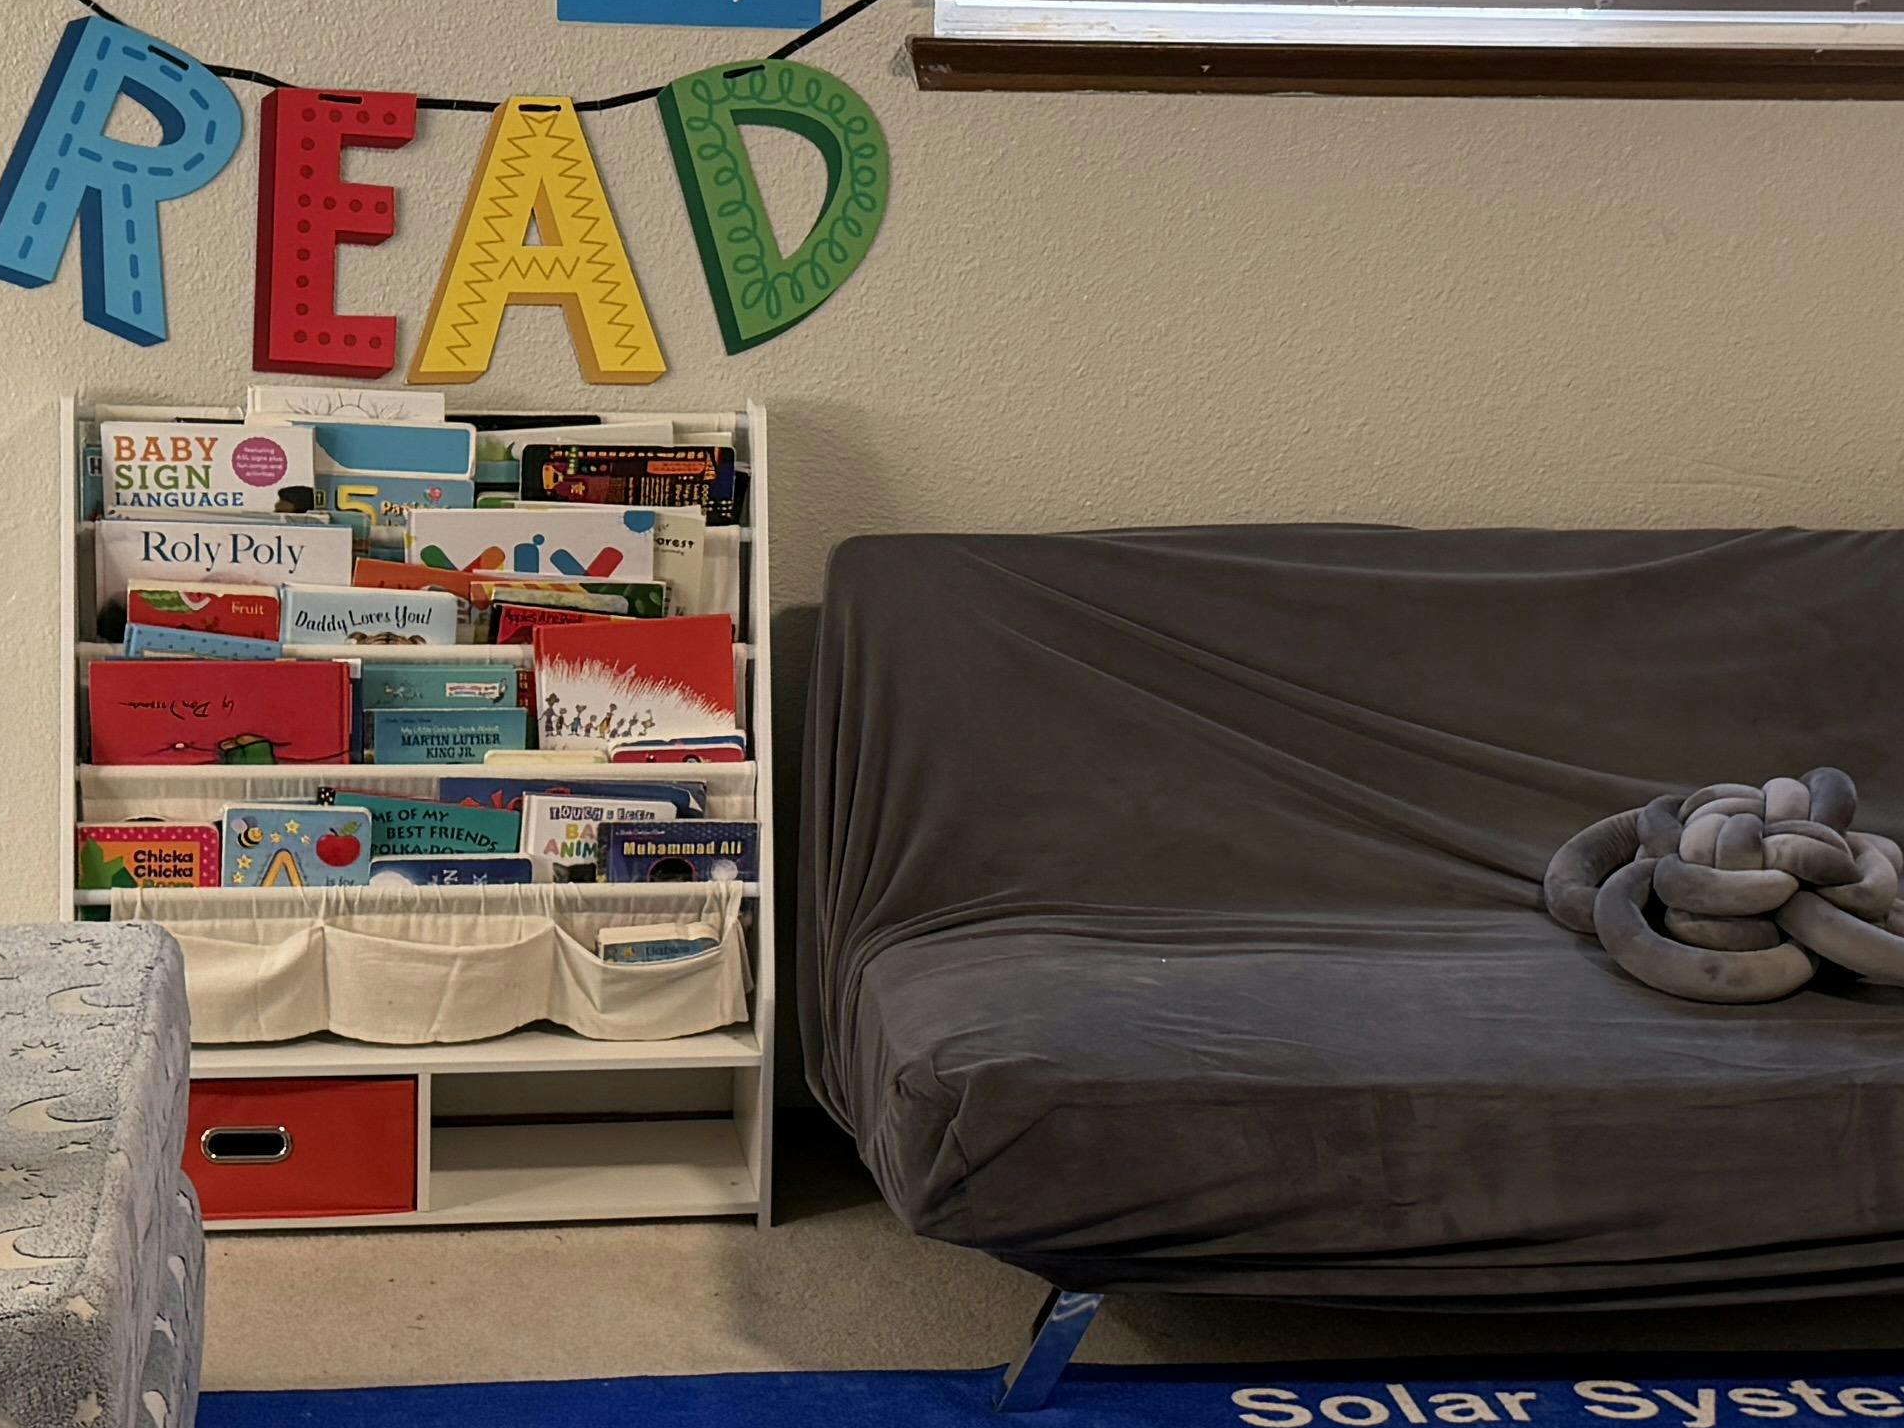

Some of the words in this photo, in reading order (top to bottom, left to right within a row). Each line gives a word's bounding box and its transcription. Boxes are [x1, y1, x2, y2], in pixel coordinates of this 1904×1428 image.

[113, 435, 219, 463] BABY
[114, 464, 212, 490] SIGN
[114, 491, 245, 508] LANGUAGE
[336, 484, 380, 526] 5
[653, 537, 696, 549] orest
[141, 530, 223, 572] Roly
[229, 533, 305, 574] Poly
[231, 600, 265, 616] Fruit
[295, 609, 348, 634] Daddy
[351, 609, 392, 627] Loves
[393, 605, 434, 628] You!
[181, 699, 211, 719] Don
[400, 733, 450, 747] MARTIN
[452, 732, 501, 746] LUTHER
[425, 746, 455, 759] KING
[458, 747, 476, 758] JR.
[398, 810, 418, 823] OF
[420, 811, 451, 825] MY
[549, 805, 604, 821] TOUCH
[386, 825, 428, 841] BEST
[430, 826, 500, 854] FRIENDS
[623, 841, 716, 856] Muhammad
[720, 841, 742, 855] Ali
[133, 849, 194, 865] Chicka
[133, 864, 194, 879] Chicka
